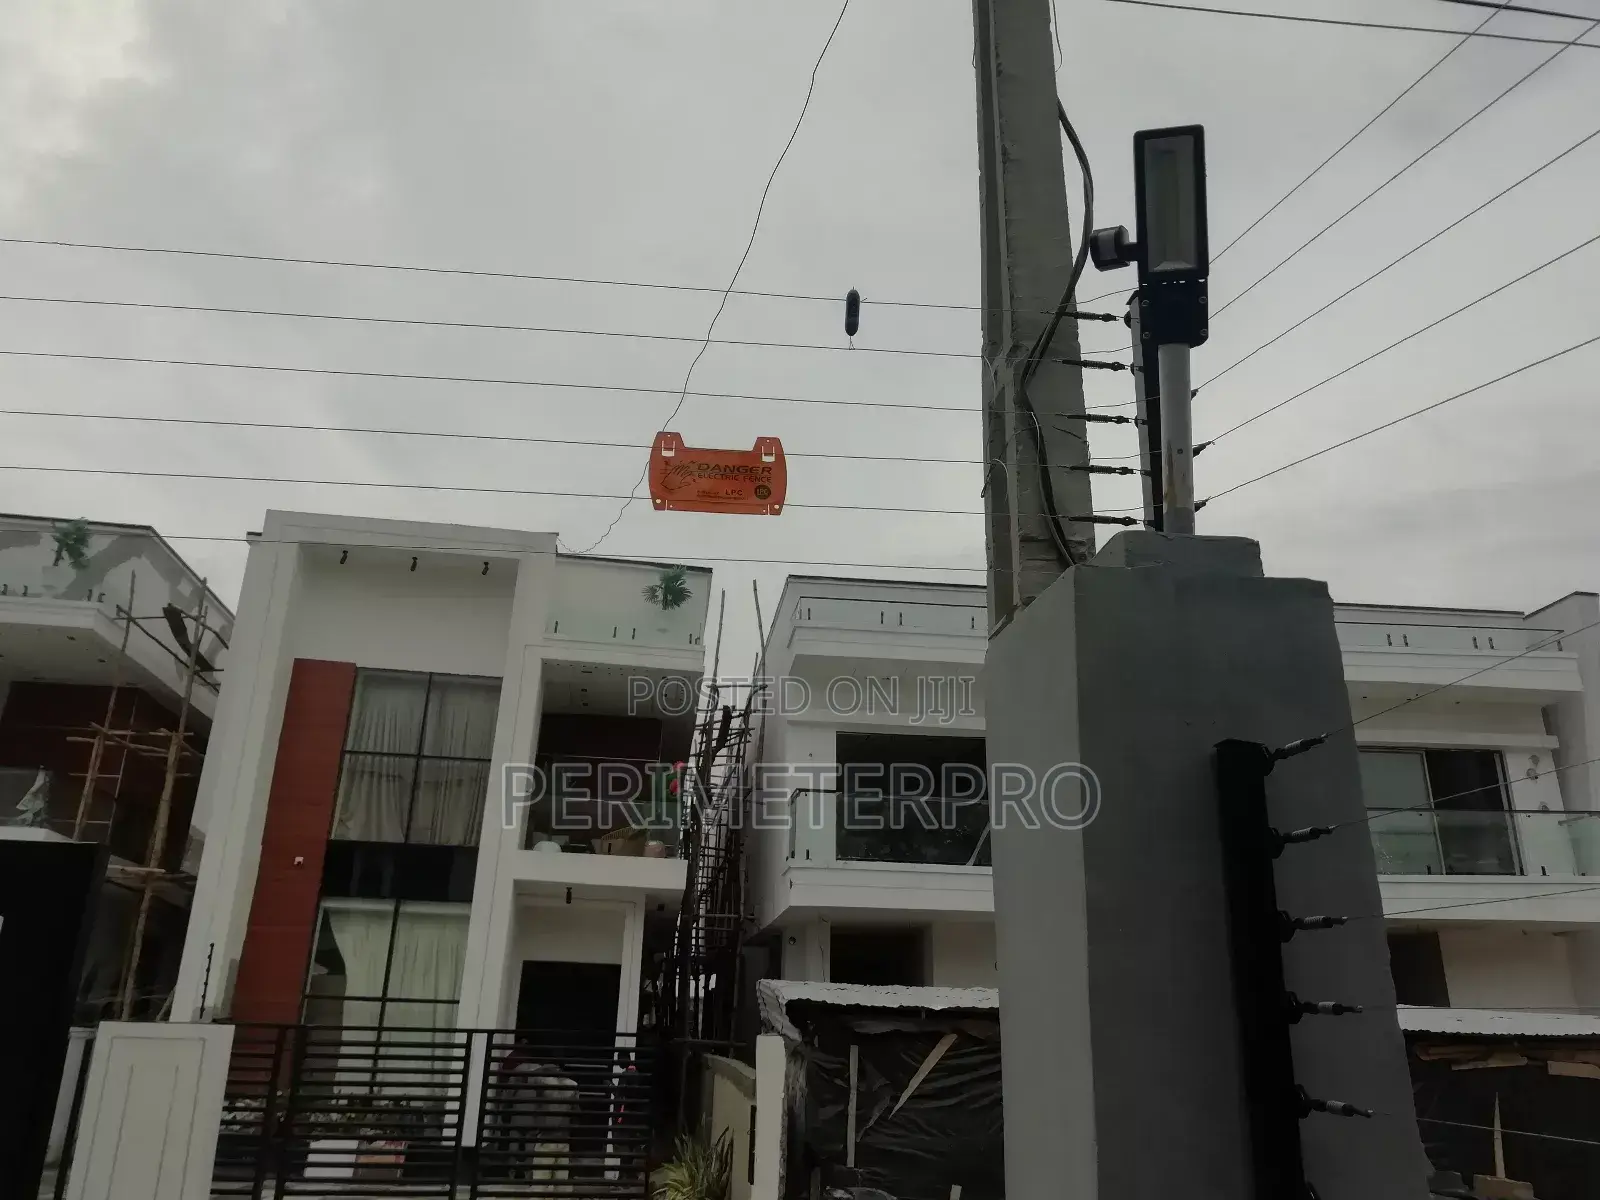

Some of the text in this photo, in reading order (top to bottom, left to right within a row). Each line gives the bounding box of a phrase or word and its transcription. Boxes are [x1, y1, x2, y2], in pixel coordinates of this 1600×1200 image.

[697, 463, 772, 474] DANGER
[697, 473, 772, 483] ELECTRIC FENCE
